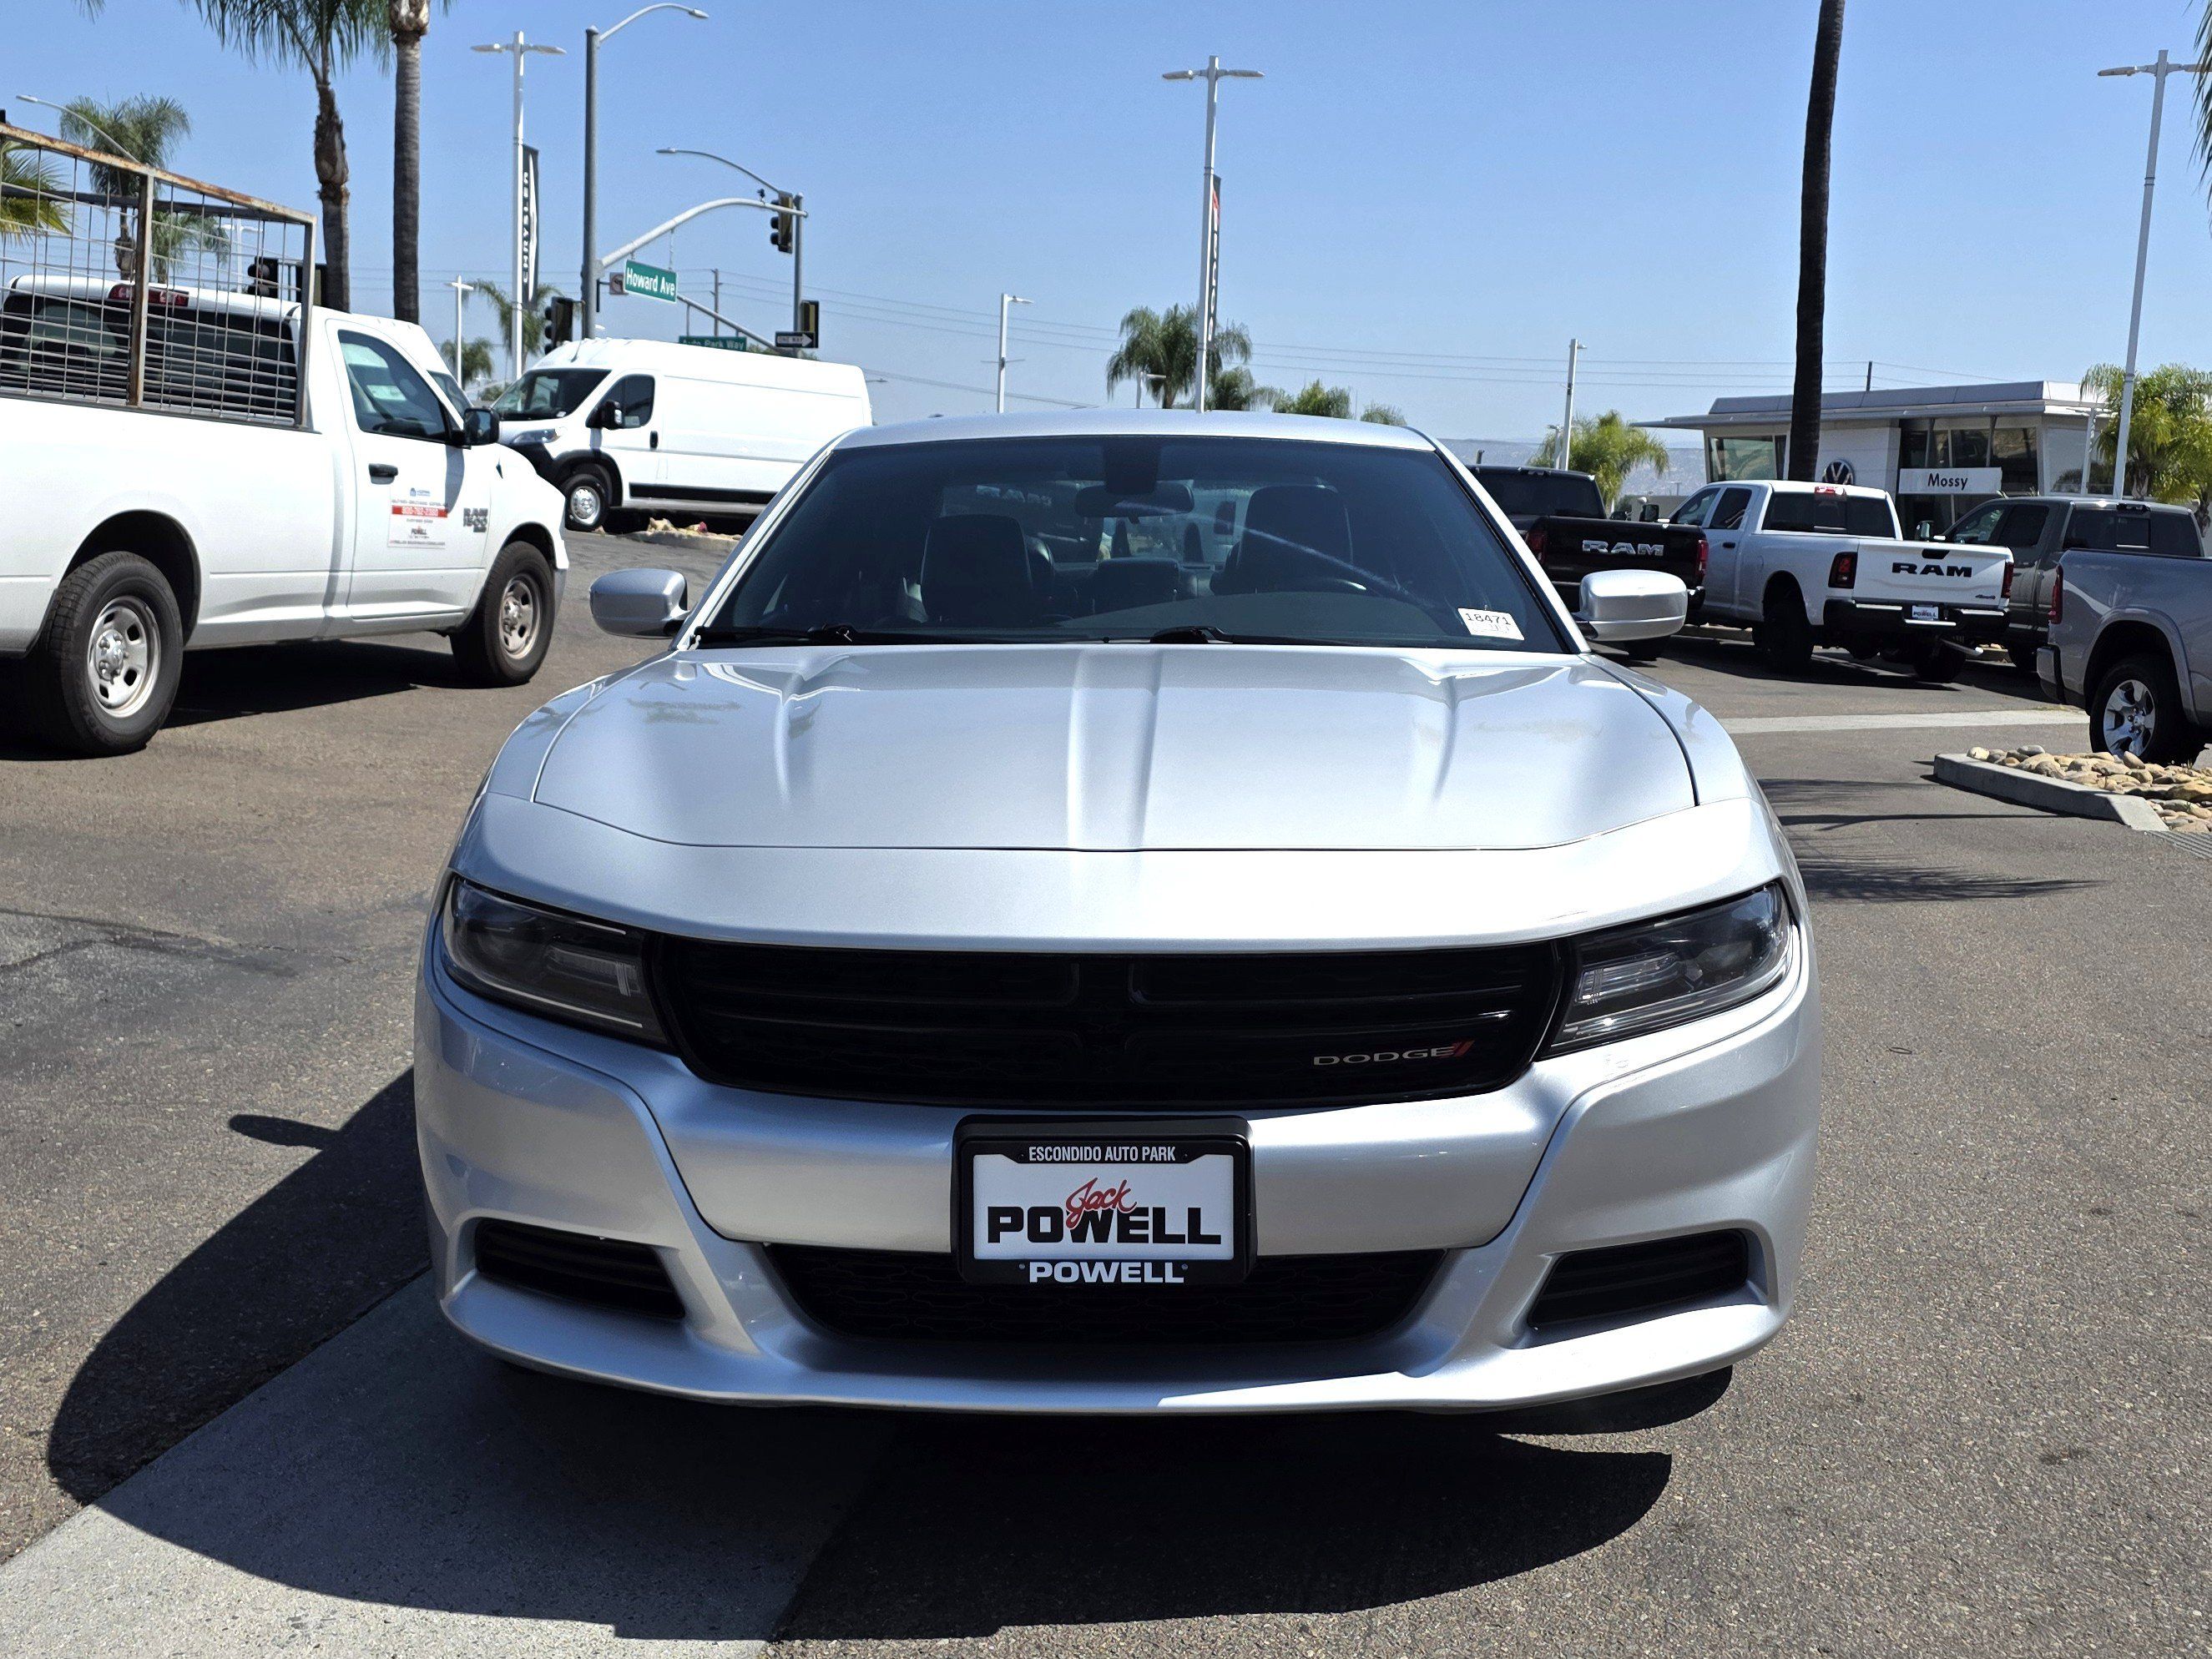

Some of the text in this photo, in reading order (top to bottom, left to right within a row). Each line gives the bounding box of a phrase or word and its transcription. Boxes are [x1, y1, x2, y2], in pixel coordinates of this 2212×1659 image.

[626, 267, 675, 296] Howard Ave
[725, 340, 744, 350] Way
[1927, 473, 1968, 490] Mossy
[1582, 539, 1664, 557] RAM
[1891, 562, 1972, 577] RAM
[1466, 613, 1511, 625] 18471
[1313, 1046, 1456, 1066] DODGE
[1028, 1146, 1176, 1162] ESCONDIDO AUTO PARK
[1065, 1177, 1138, 1230] Jack
[987, 1206, 1222, 1245] POWELL
[1029, 1262, 1184, 1283] POWELL
